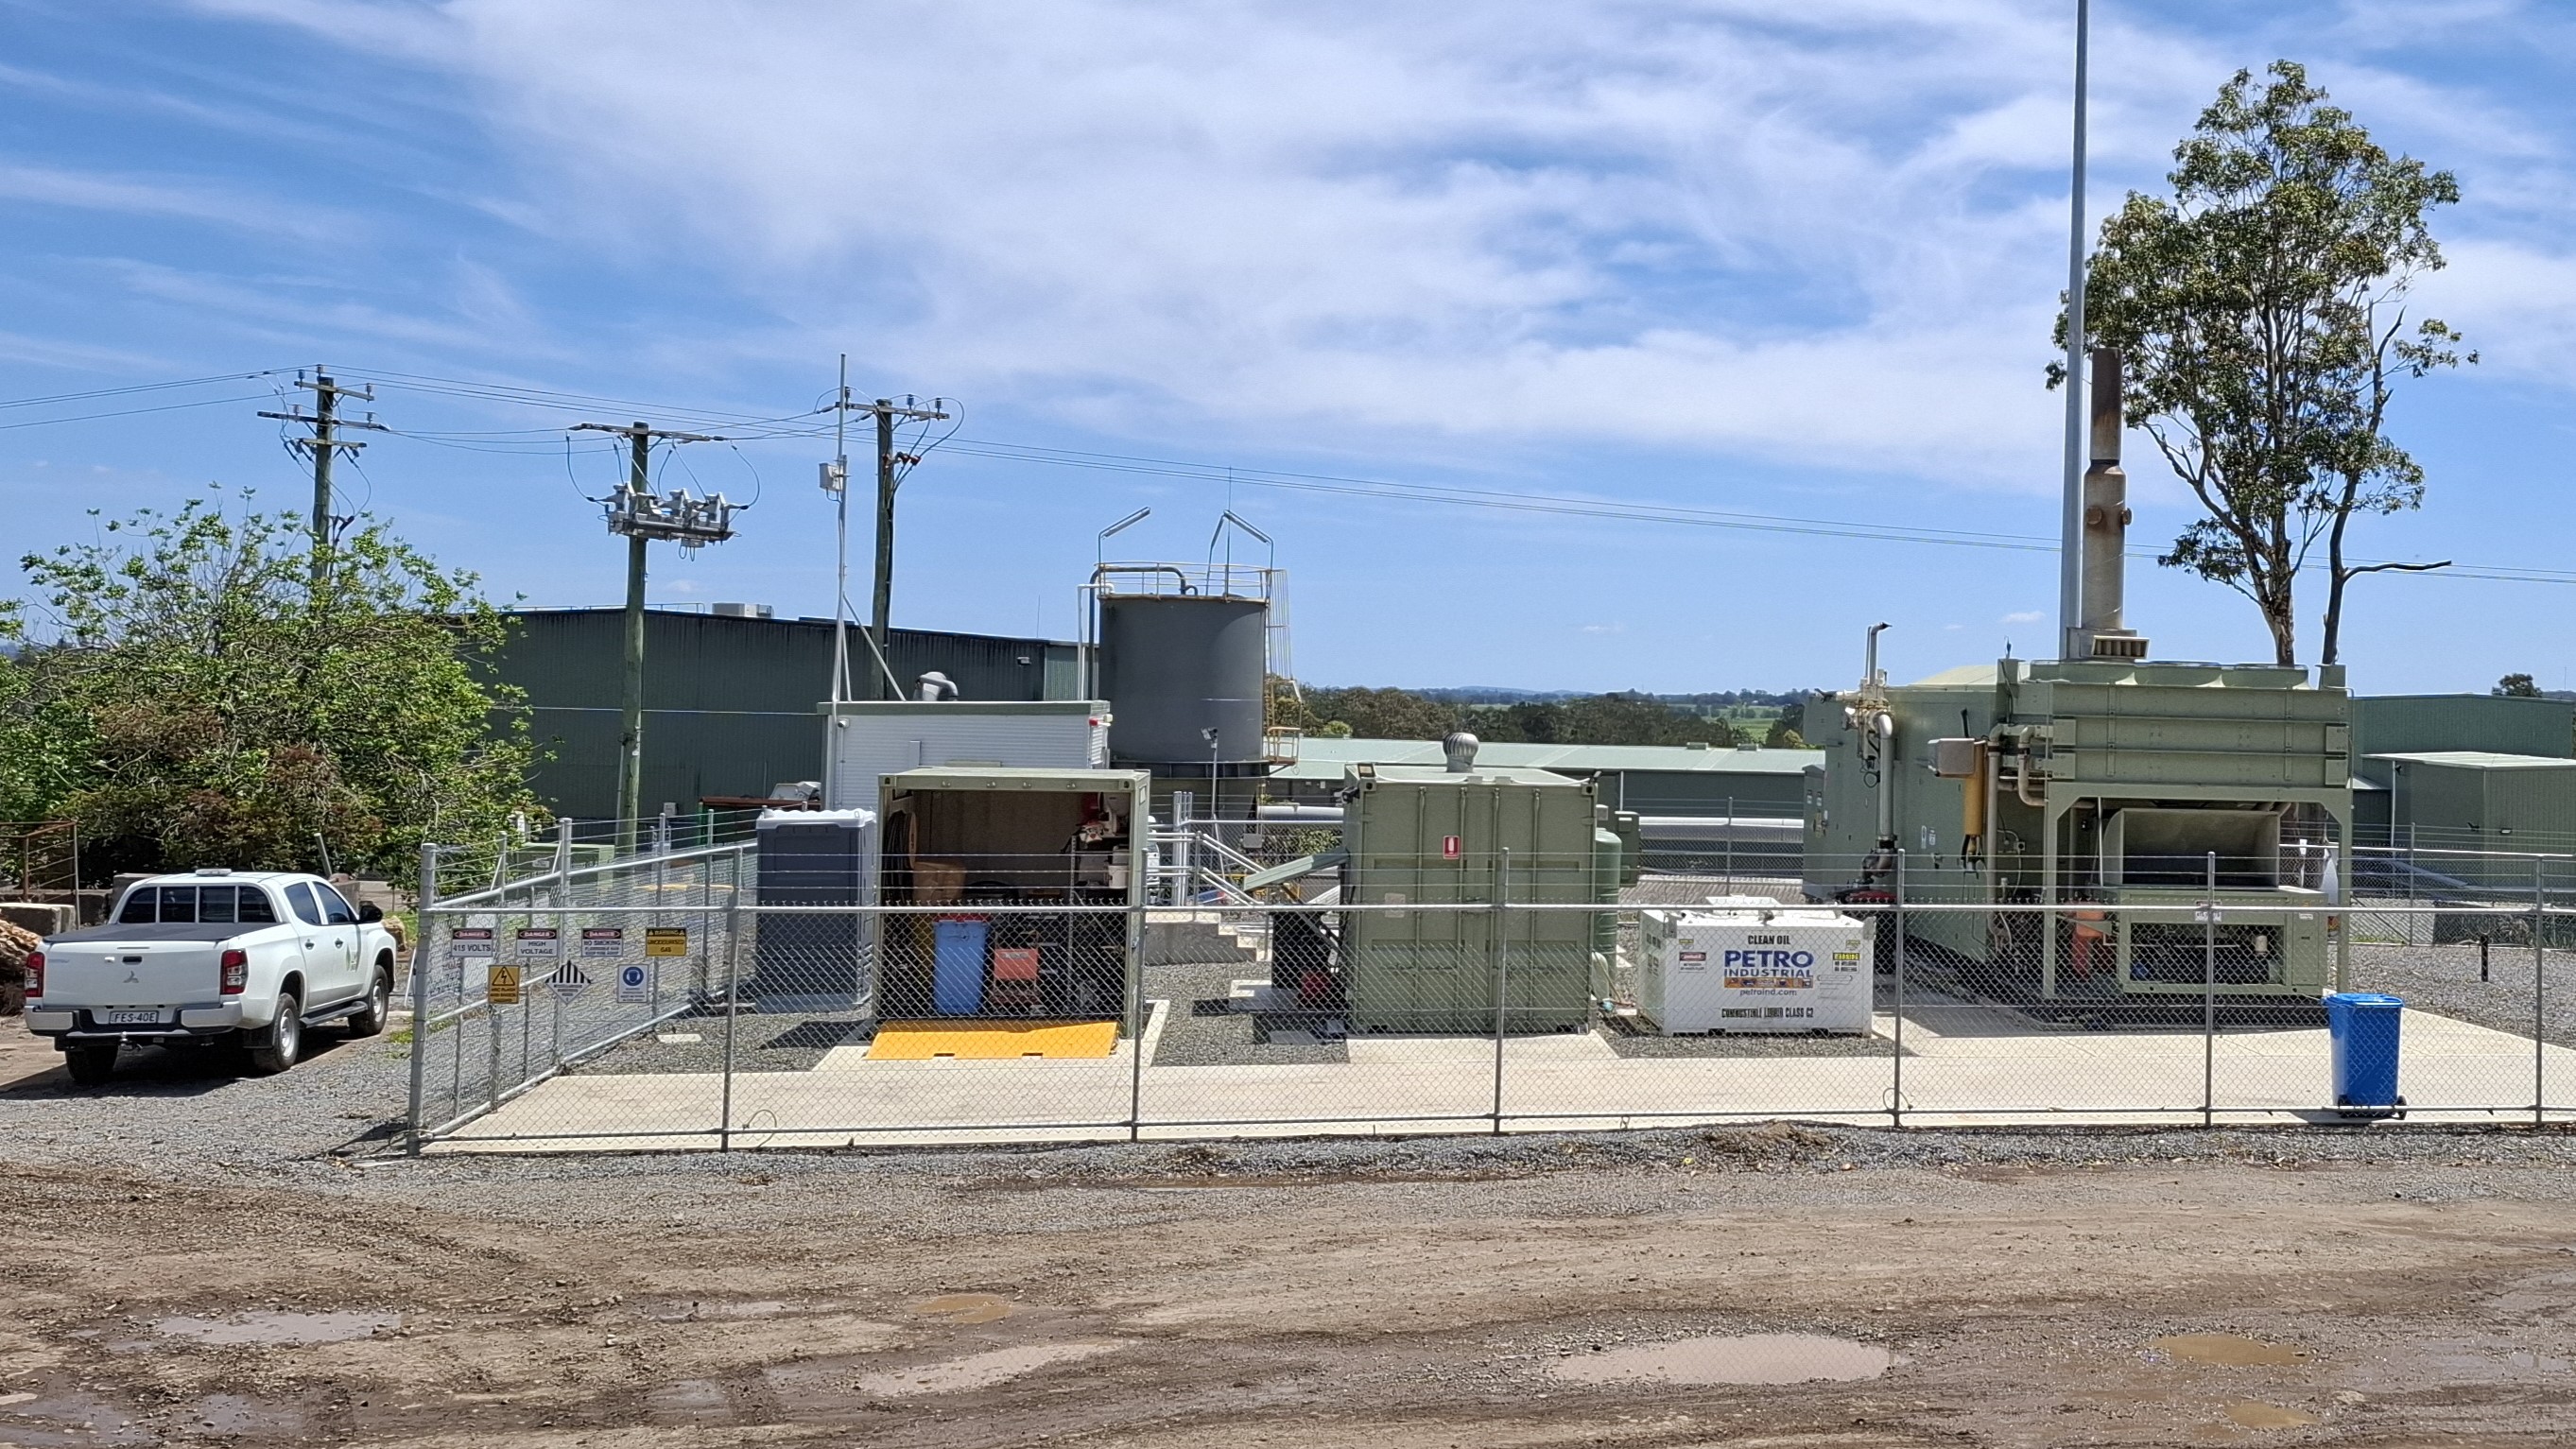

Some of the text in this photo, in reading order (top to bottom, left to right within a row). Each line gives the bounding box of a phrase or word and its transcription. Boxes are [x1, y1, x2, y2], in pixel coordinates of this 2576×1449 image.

[1748, 935, 1791, 945] CLEAN OIL
[1724, 950, 1814, 968] PETRO
[1723, 968, 1813, 977] INDUSTRIAL
[1739, 988, 1797, 996] petroind.com
[1785, 1007, 1804, 1018] CLASS
